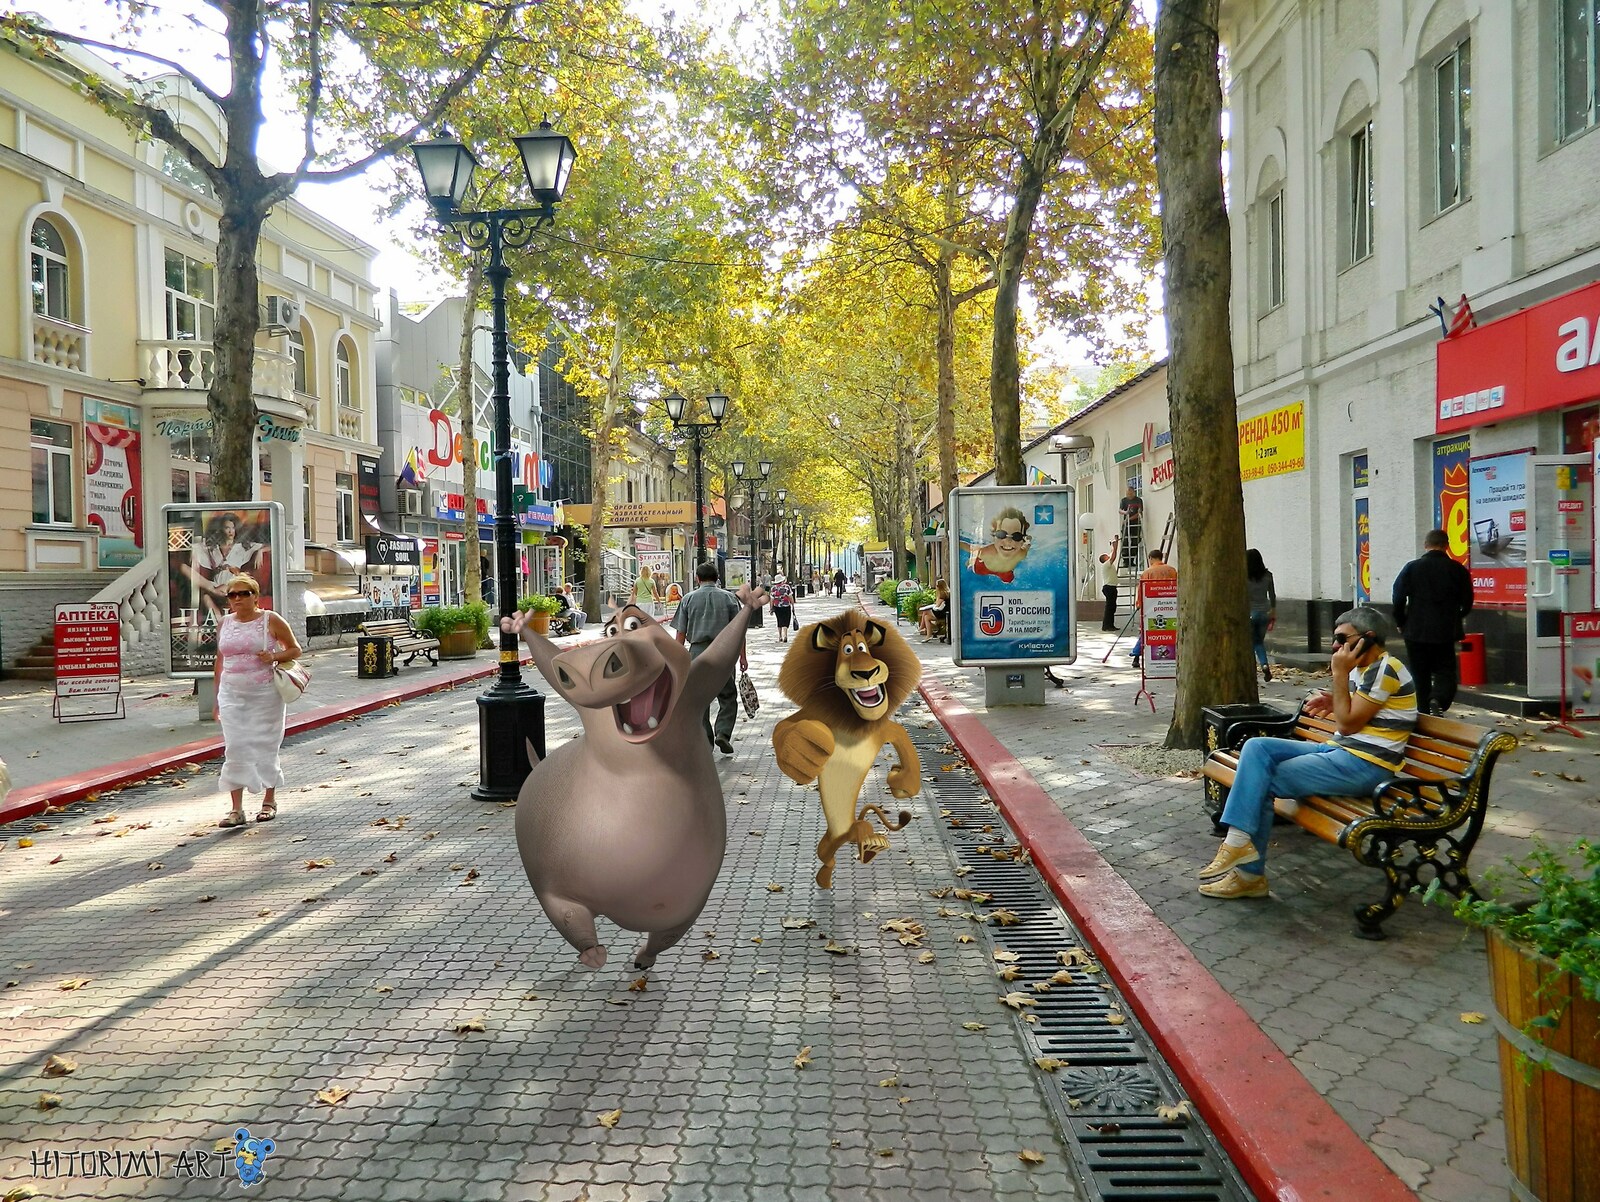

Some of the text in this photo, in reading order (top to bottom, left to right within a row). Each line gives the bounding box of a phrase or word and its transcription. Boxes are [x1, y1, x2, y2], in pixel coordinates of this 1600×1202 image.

[1271, 410, 1289, 435] 450
[1264, 447, 1277, 458] этаж
[389, 540, 414, 551] FASHION
[395, 552, 410, 562] SOUL
[57, 610, 118, 621] АПТЕКА
[979, 596, 1005, 636] 5
[1008, 606, 1050, 615] В РОССИЮ
